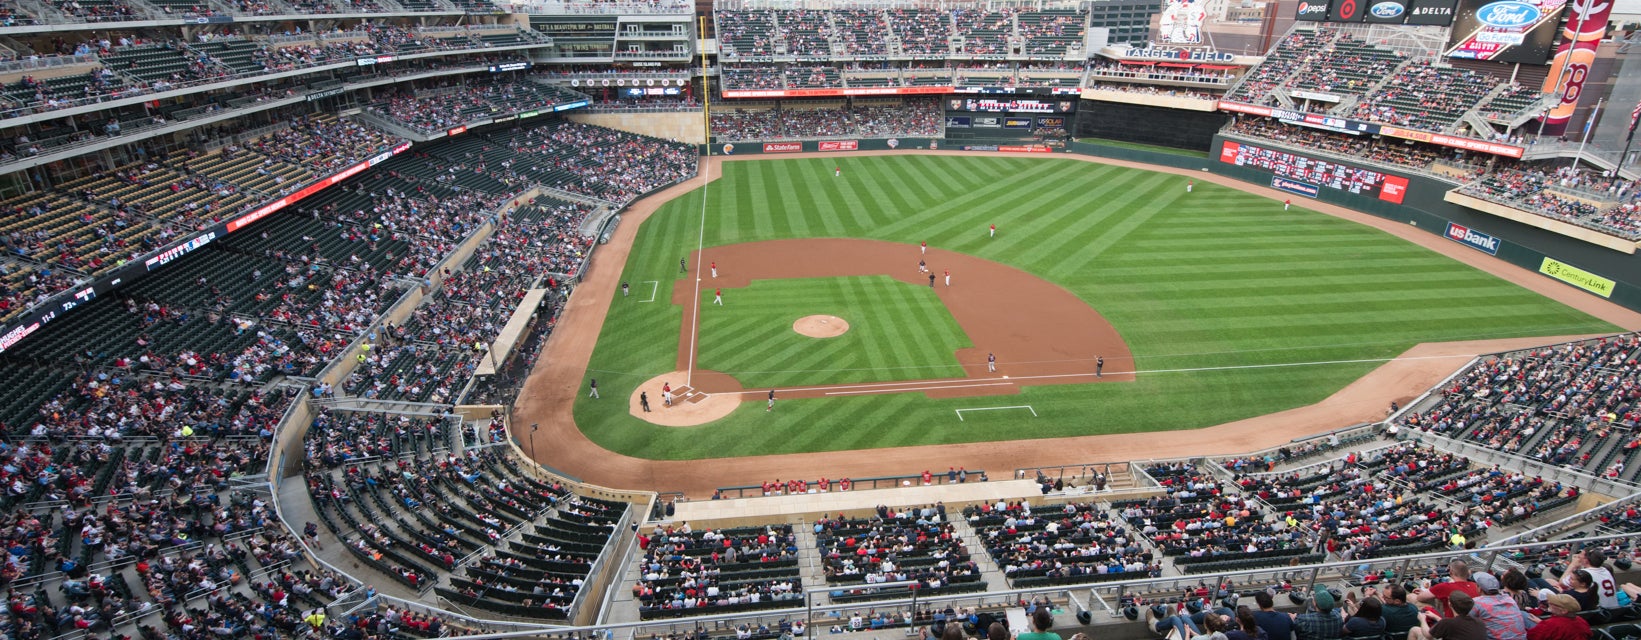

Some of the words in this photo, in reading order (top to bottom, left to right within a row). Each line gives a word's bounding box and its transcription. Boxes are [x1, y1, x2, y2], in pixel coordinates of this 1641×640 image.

[1307, 4, 1327, 13] pepsi
[1376, 5, 1398, 15] Ford
[1421, 7, 1451, 15] DELTA
[1486, 4, 1529, 23] Ford
[1491, 34, 1523, 42] Further
[1125, 49, 1179, 59] TARGET
[1191, 51, 1234, 62] FIELD
[1561, 62, 1589, 105] B
[1448, 138, 1466, 147] CLINIC
[1466, 141, 1489, 151] SPORTS
[1489, 145, 1519, 155] MEDICINE
[1561, 268, 1607, 291] CenturyLink
[0, 324, 26, 344] HUGHES
[1602, 579, 1615, 597] 9
